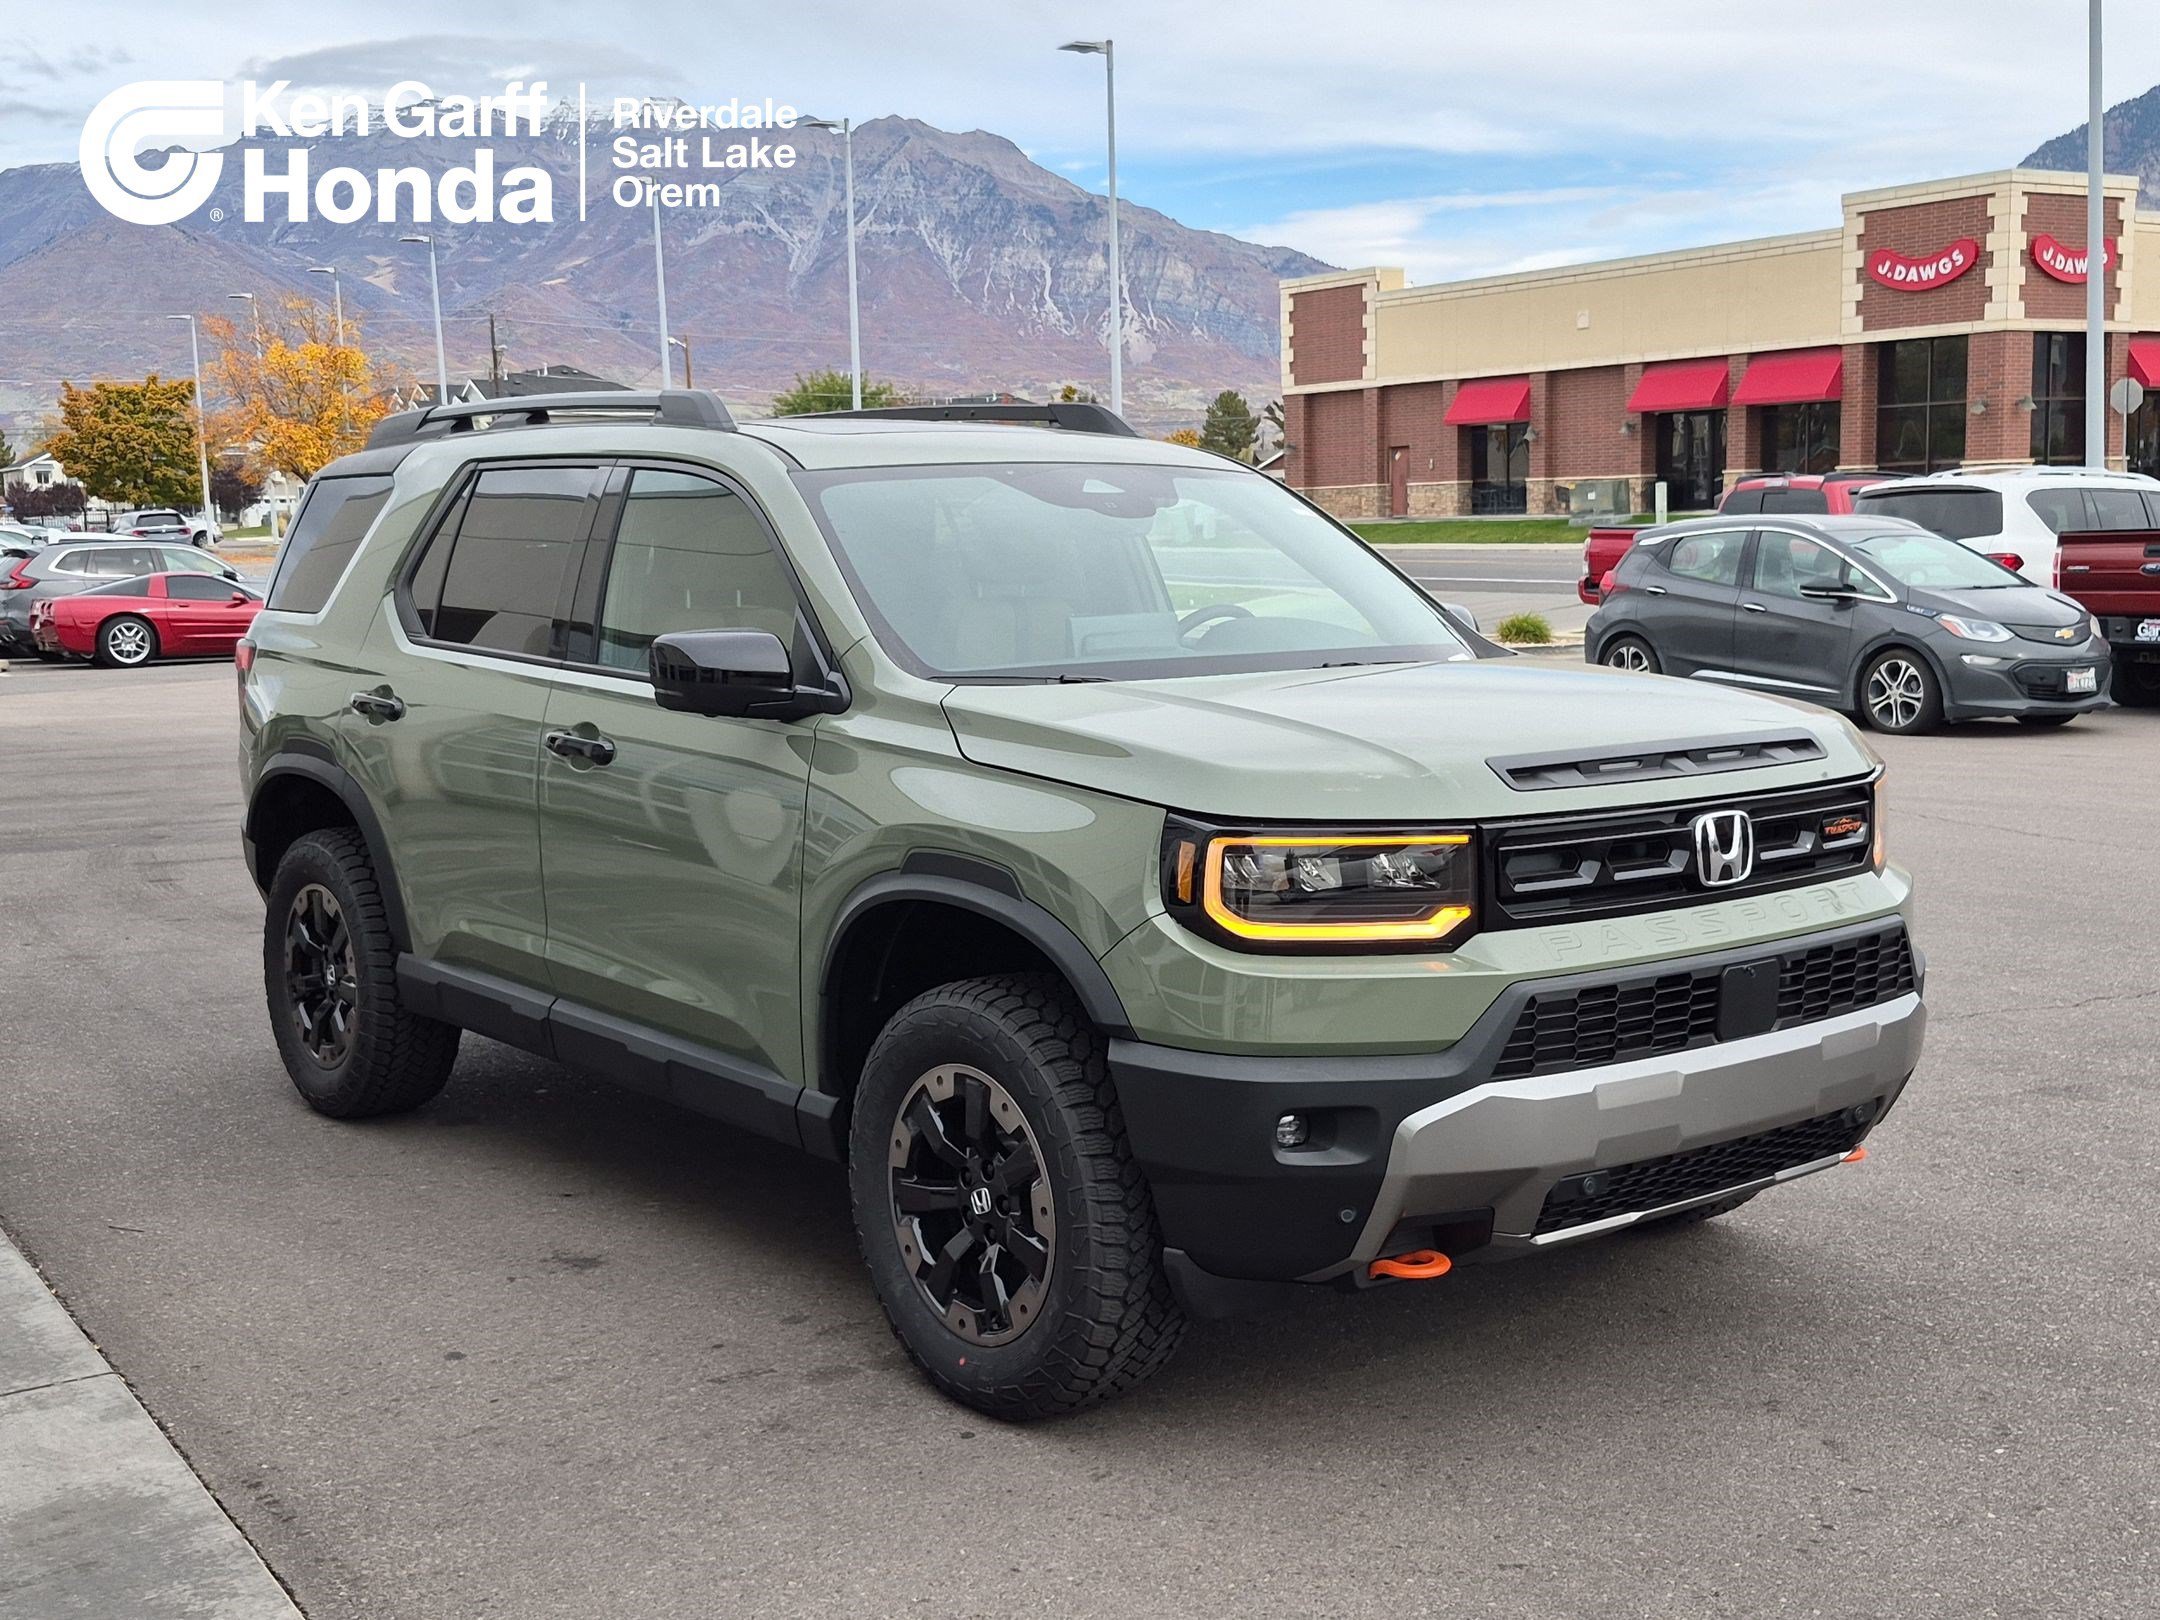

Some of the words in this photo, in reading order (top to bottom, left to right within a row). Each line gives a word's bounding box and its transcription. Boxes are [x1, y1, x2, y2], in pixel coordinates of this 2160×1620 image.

[1877, 248, 1964, 283] J.DAWGS
[2042, 246, 2108, 275] J.DAW
[1538, 881, 1867, 963] PASSPORT
